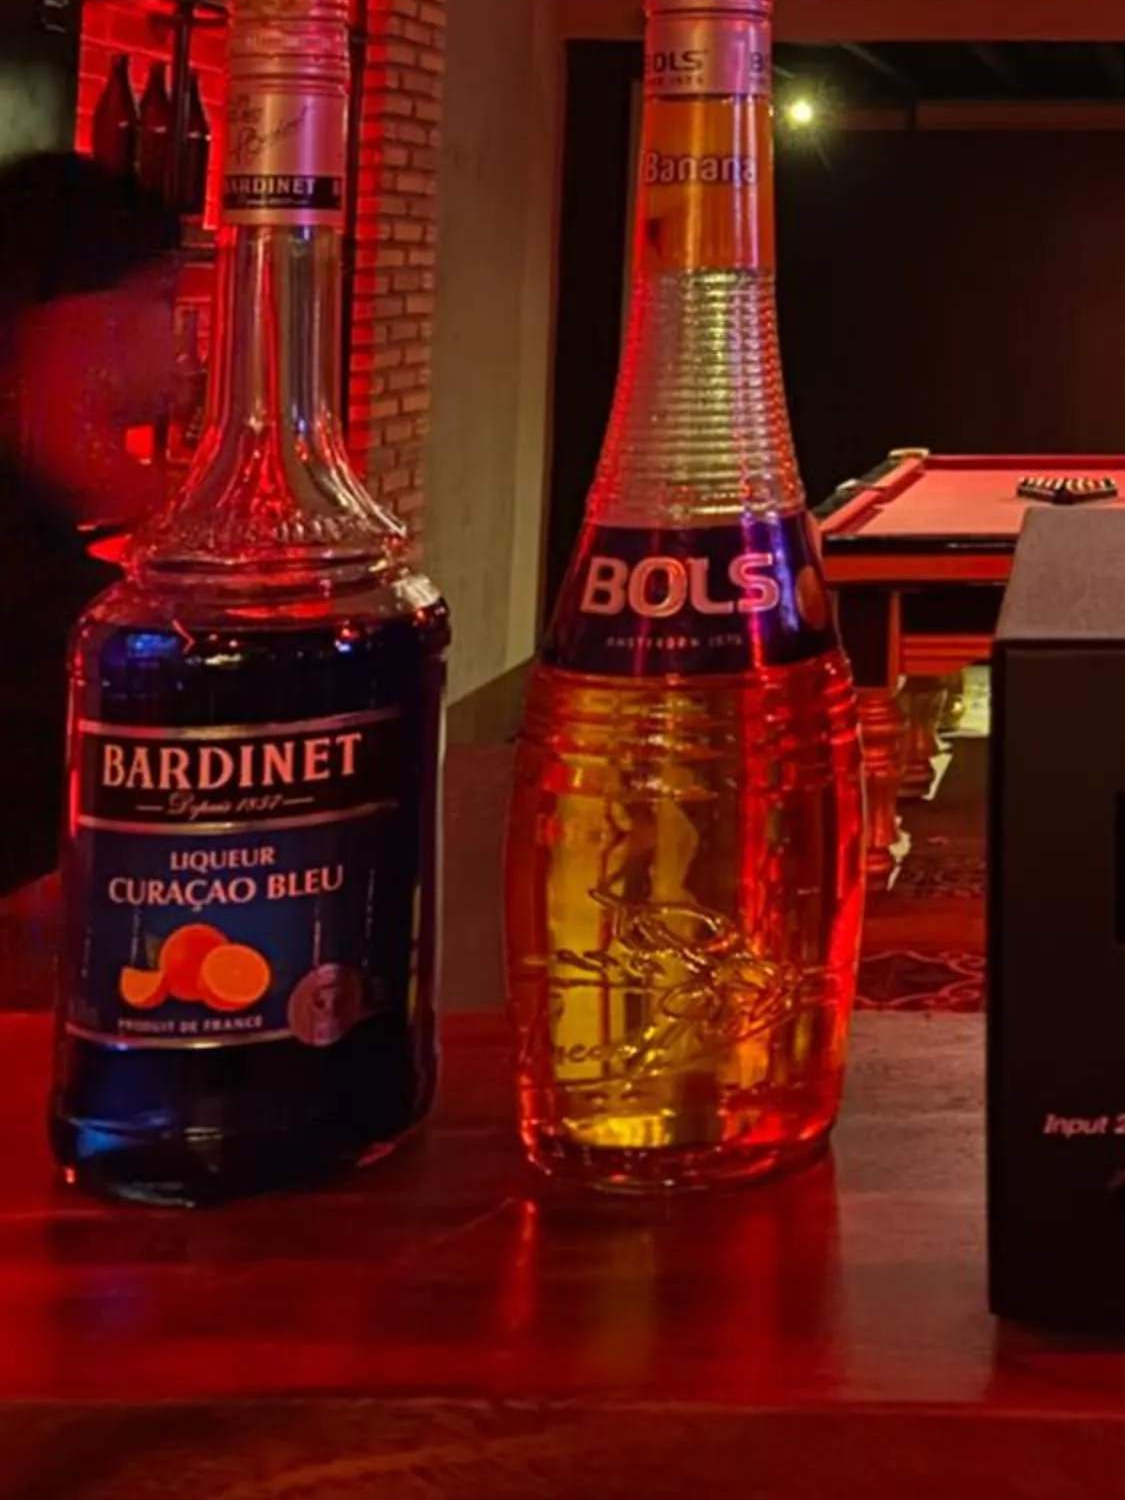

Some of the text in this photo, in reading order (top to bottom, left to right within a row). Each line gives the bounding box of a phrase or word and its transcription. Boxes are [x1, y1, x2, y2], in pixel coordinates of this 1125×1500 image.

[645, 153, 757, 182] Banana
[580, 553, 780, 617] BOLS
[102, 733, 362, 790] BARDINET
[170, 847, 275, 873] LIQUEUR
[109, 864, 344, 912] CURAÇAO BLEU
[180, 1017, 197, 1032] DE
[203, 1015, 263, 1031] FRANCE
[1043, 1113, 1109, 1140] Input
